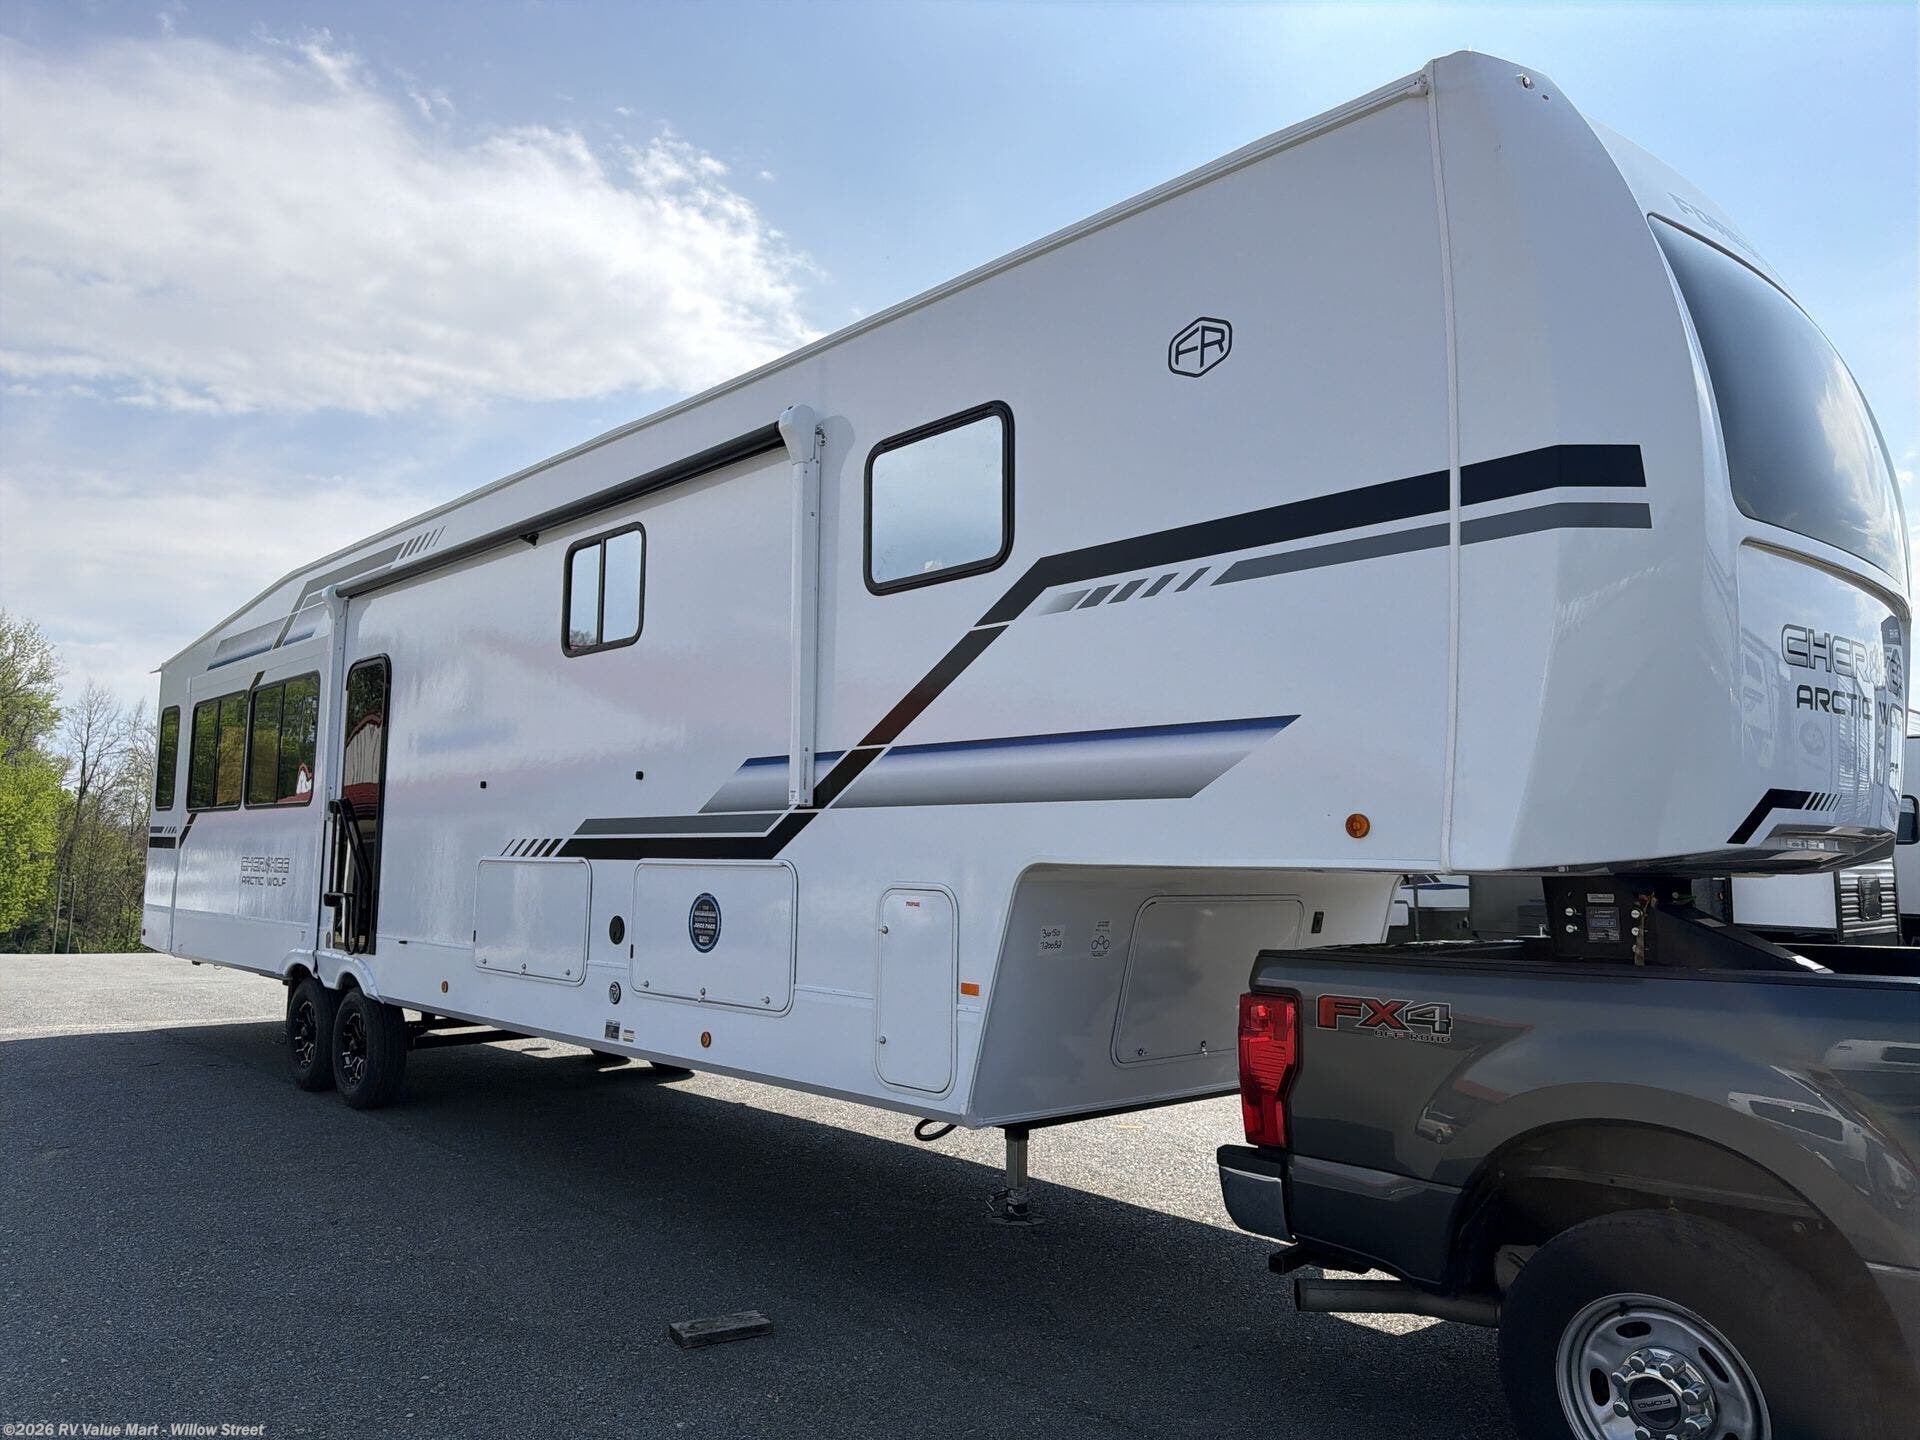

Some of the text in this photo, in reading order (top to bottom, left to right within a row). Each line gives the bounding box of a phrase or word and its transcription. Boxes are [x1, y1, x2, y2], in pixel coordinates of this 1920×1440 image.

[1796, 684, 1872, 720] ARCTIC
[241, 875, 287, 887] ARCTIC WOLF
[1316, 993, 1453, 1036] FX4
[1373, 1030, 1452, 1043] OFF ROAD
[1638, 1398, 1671, 1409] FORD
